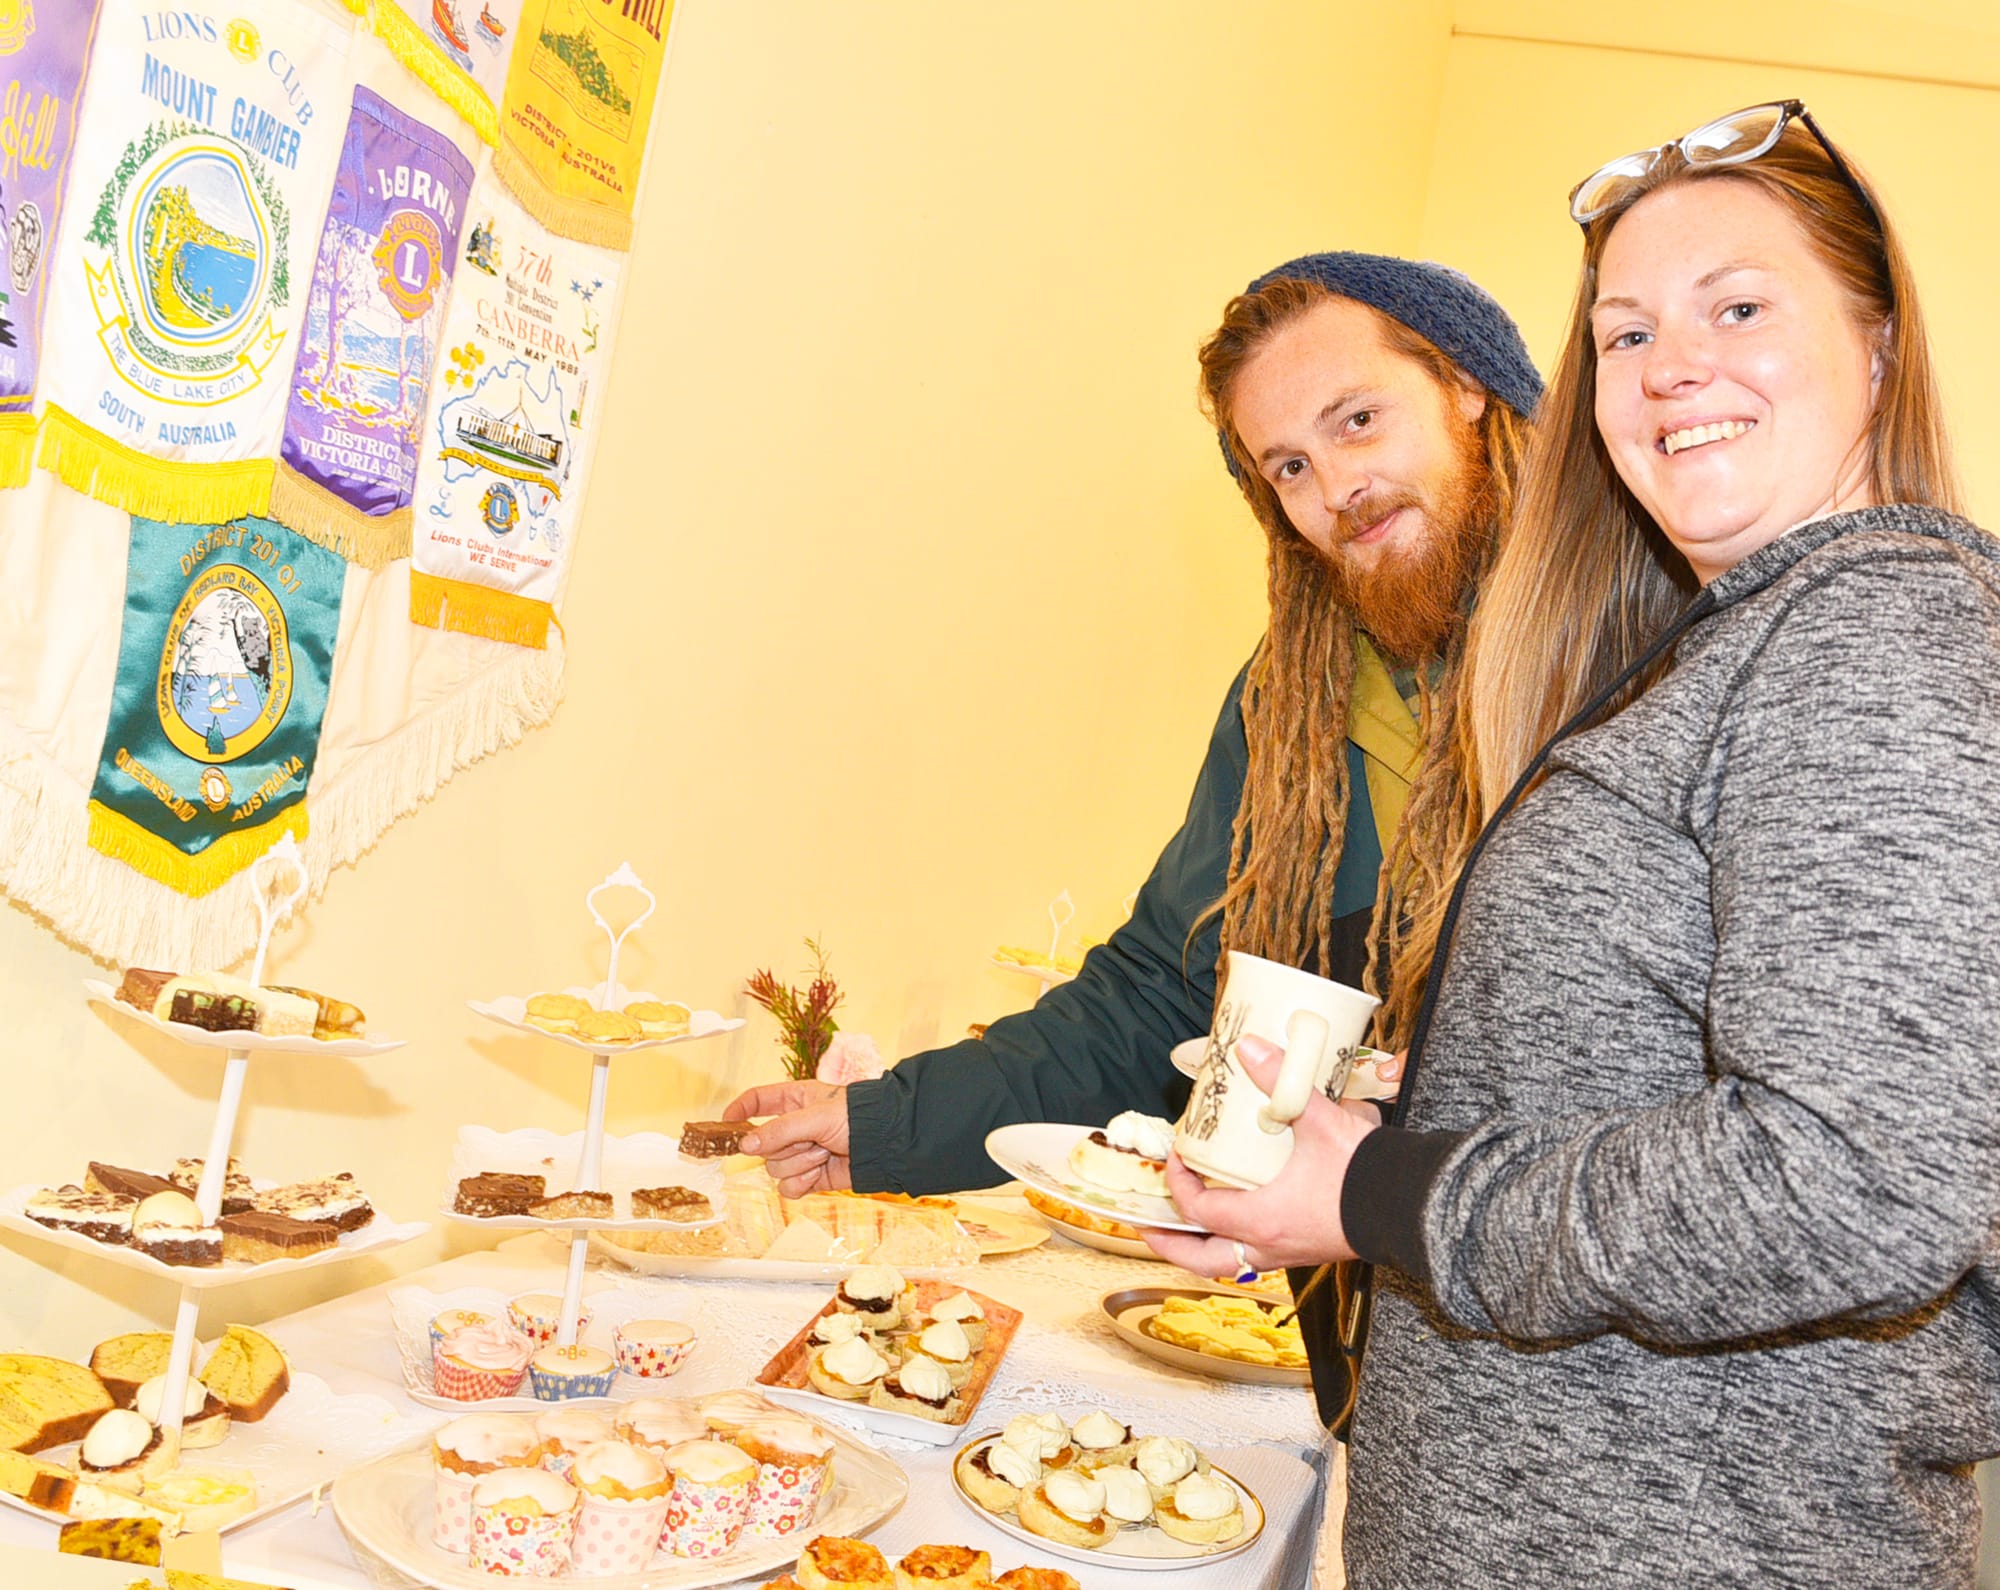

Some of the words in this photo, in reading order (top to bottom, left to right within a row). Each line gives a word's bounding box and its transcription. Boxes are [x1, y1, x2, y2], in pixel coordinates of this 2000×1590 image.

[142, 11, 218, 43] LIONS
[268, 49, 314, 126] CLUB
[141, 52, 217, 127] MOUNT
[231, 97, 301, 170] GAMBIER
[511, 108, 556, 149] VICTORIA
[525, 103, 567, 141] DISTRICT
[577, 148, 617, 175] 201V6
[400, 242, 423, 288] L
[477, 298, 580, 362] CANBERRA
[524, 346, 547, 363] MAY
[110, 332, 128, 366] THE
[128, 363, 163, 393] BLUE
[173, 383, 214, 400] LAKE
[219, 372, 246, 396] CITY
[98, 390, 146, 433] SOUTH
[158, 420, 237, 446] AUSTRALIA
[299, 436, 381, 474] VICTORIA
[180, 525, 248, 576] DISTRICT
[251, 534, 280, 567] 201
[277, 564, 302, 594] Q1
[431, 530, 462, 546] Lions
[467, 538, 494, 554] Clubs
[498, 547, 553, 568] International
[469, 552, 487, 565] WE
[490, 557, 517, 572] SERVE
[238, 575, 260, 596] BAY
[266, 605, 287, 673] VICTORIA
[115, 747, 198, 822] QUEENSLAND
[231, 755, 305, 823] AUSTRALIA
